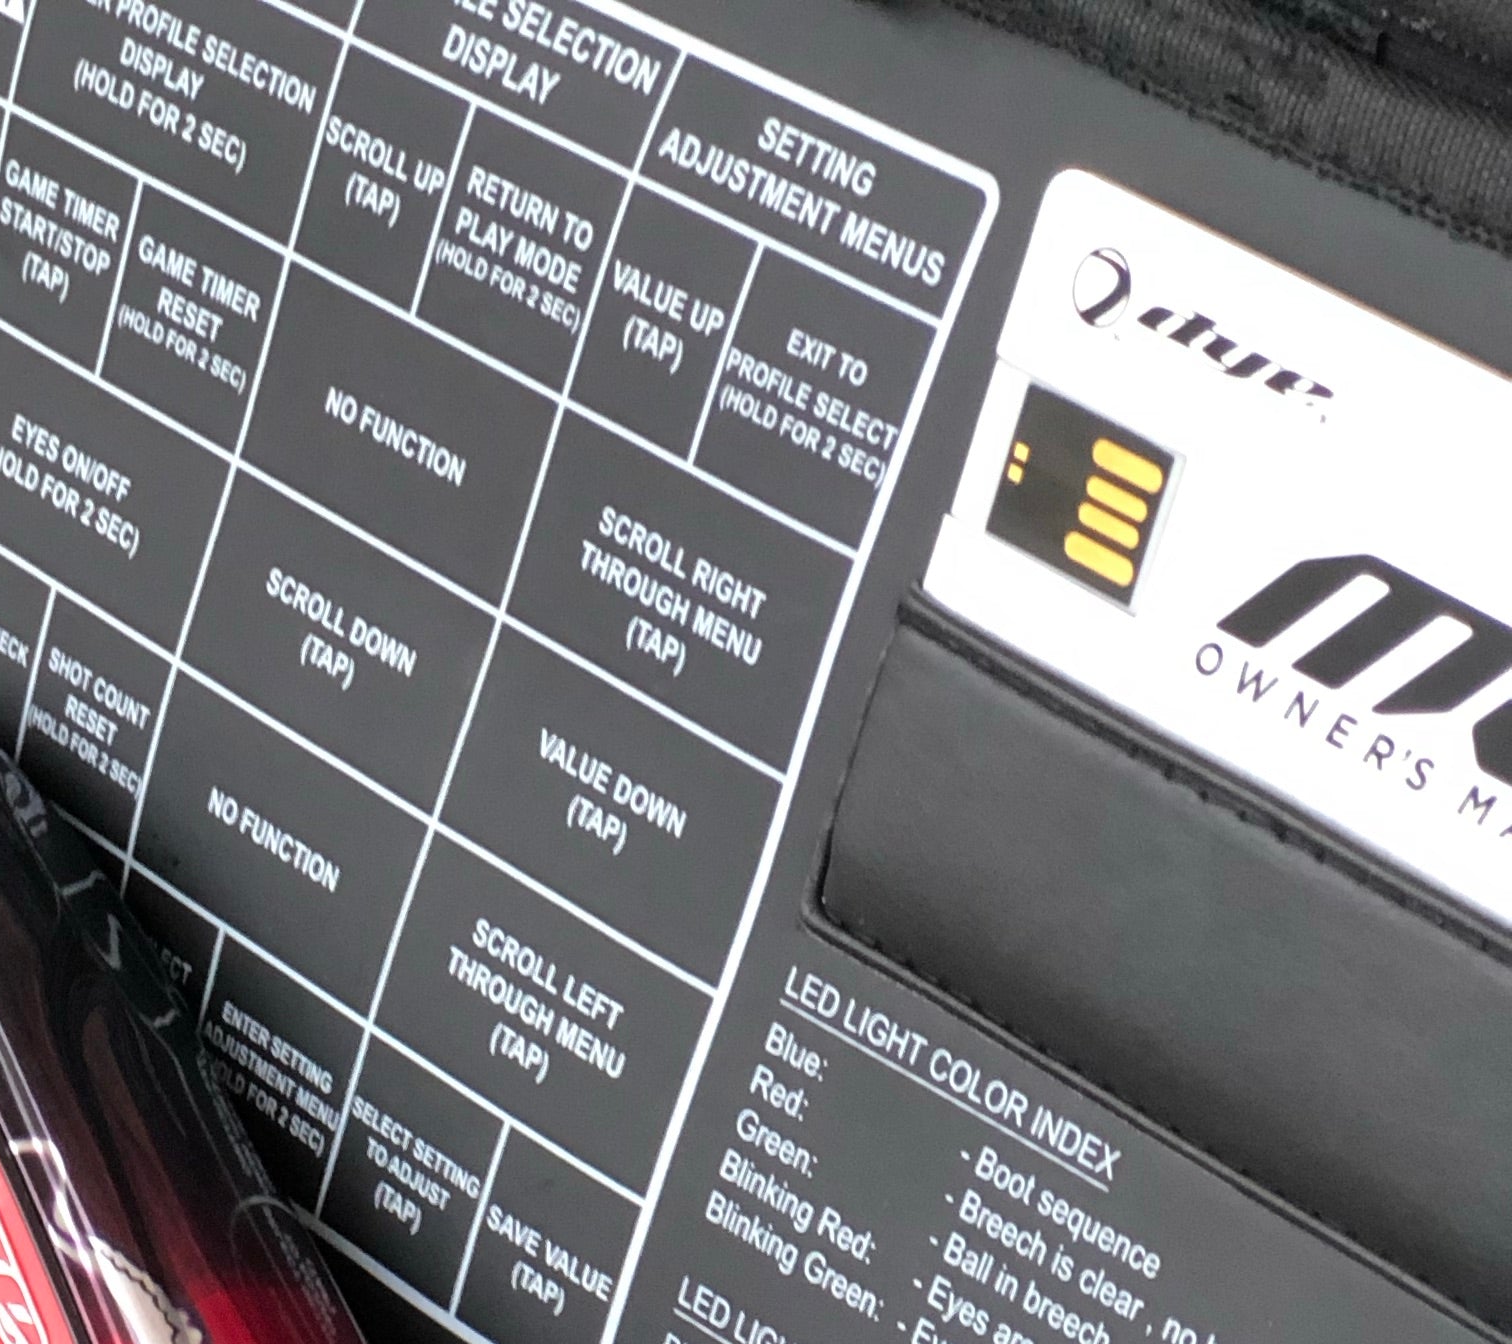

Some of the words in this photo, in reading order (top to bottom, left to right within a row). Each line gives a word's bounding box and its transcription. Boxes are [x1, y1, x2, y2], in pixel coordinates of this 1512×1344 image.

[115, 0, 201, 56] PROFILE
[201, 33, 316, 114] SELECTION
[119, 36, 204, 100] DISPLAY
[441, 23, 561, 103] DISPLAY
[501, 0, 661, 95] SELECTION
[73, 58, 135, 109] (HOLD
[136, 89, 180, 134] FOR
[180, 112, 196, 143] 2
[197, 120, 246, 173] SEC)
[325, 115, 407, 182] SCROLL
[412, 159, 445, 195] UP
[757, 116, 876, 196] SETTING
[4, 158, 59, 209] GAME
[63, 187, 120, 242] TIMER
[344, 171, 400, 227] (TAP)
[466, 164, 559, 234] RETURN
[562, 210, 593, 251] TO
[657, 127, 841, 235] ADJUSTMENT
[839, 210, 945, 286] MENUS
[21, 253, 69, 303] (TAP)
[137, 234, 197, 287] GAME
[200, 265, 260, 322] TIMER
[434, 238, 488, 281] (HOLD
[489, 264, 526, 301] FOR
[525, 284, 540, 308] 2
[539, 290, 581, 334] SEC)
[454, 207, 514, 256] PLAY
[513, 235, 582, 294] MODE
[156, 287, 223, 341] RESET
[613, 258, 688, 321] VALUE
[689, 298, 725, 336] UP
[117, 303, 164, 344] (HOLD
[164, 327, 197, 363] FOR
[197, 347, 209, 370] 2
[209, 353, 246, 393] SEC)
[622, 314, 683, 374] (TAP)
[786, 327, 836, 370] EXIT
[838, 351, 868, 386] TO
[324, 385, 358, 424] NO
[358, 404, 466, 486] FUNCTION
[718, 383, 778, 429] (HOLD
[779, 412, 821, 452] FOR
[820, 434, 836, 460] 2
[837, 442, 886, 489] SEC)
[725, 346, 812, 410] PROFILE
[812, 391, 898, 450] SELECT
[10, 413, 60, 462] EYES
[61, 444, 131, 499] ON/OFF
[39, 472, 80, 518] FOR
[79, 497, 95, 526] 2
[94, 506, 139, 556] SEC)
[580, 539, 690, 626] THROUGH
[691, 604, 762, 665] MENU
[598, 505, 686, 579] SCROLL
[691, 557, 766, 619] RIGHT
[265, 566, 344, 637] SCROLL
[348, 615, 417, 677] DOWN
[299, 632, 354, 690] (TAP)
[625, 615, 686, 676] (TAP)
[47, 646, 93, 691] SHOT
[92, 676, 151, 729] COUNT
[64, 693, 118, 746] RESET
[1195, 642, 1435, 791] OWNER'S
[539, 727, 612, 794] VALUE
[612, 773, 687, 838] DOWN
[566, 794, 627, 855] (TAP)
[207, 786, 238, 825] NO
[238, 806, 340, 892] FUNCTION
[448, 945, 555, 1036] THROUGH
[554, 1016, 626, 1078] MENU
[471, 917, 557, 995] SCROLL
[562, 974, 624, 1029] LEFT
[221, 1000, 271, 1050] ENTER
[269, 1035, 333, 1094] SETTING
[489, 1021, 549, 1084] (TAP)
[764, 1021, 828, 1082] Blue:
[783, 965, 840, 1018] LED
[842, 997, 928, 1065] LIGHT
[929, 1048, 1028, 1127] COLOR
[1029, 1105, 1121, 1179] INDEX
[749, 1064, 808, 1121] Red:
[351, 1095, 413, 1150] SELECT
[412, 1137, 480, 1199] SETTING
[366, 1135, 388, 1167] TO
[386, 1155, 451, 1210] ADJUST
[735, 1108, 818, 1178] Green:
[373, 1181, 421, 1235] (TAP)
[718, 1148, 814, 1233] Blinking
[816, 1205, 876, 1265] Red:
[974, 1145, 1035, 1206] Boot
[1036, 1189, 1160, 1279] sequence
[486, 1204, 541, 1257] SAVE
[544, 1238, 613, 1302] VALUE
[510, 1260, 565, 1316] (TAP)
[704, 1189, 798, 1275] Blinking
[803, 1250, 884, 1322] Green:
[942, 1231, 994, 1284] Ball
[993, 1262, 1018, 1301] in
[958, 1188, 1047, 1266] Breech
[1050, 1243, 1074, 1282] is
[1078, 1268, 1144, 1321] clear
[677, 1275, 730, 1329] LED
[926, 1274, 989, 1335] Eyes
